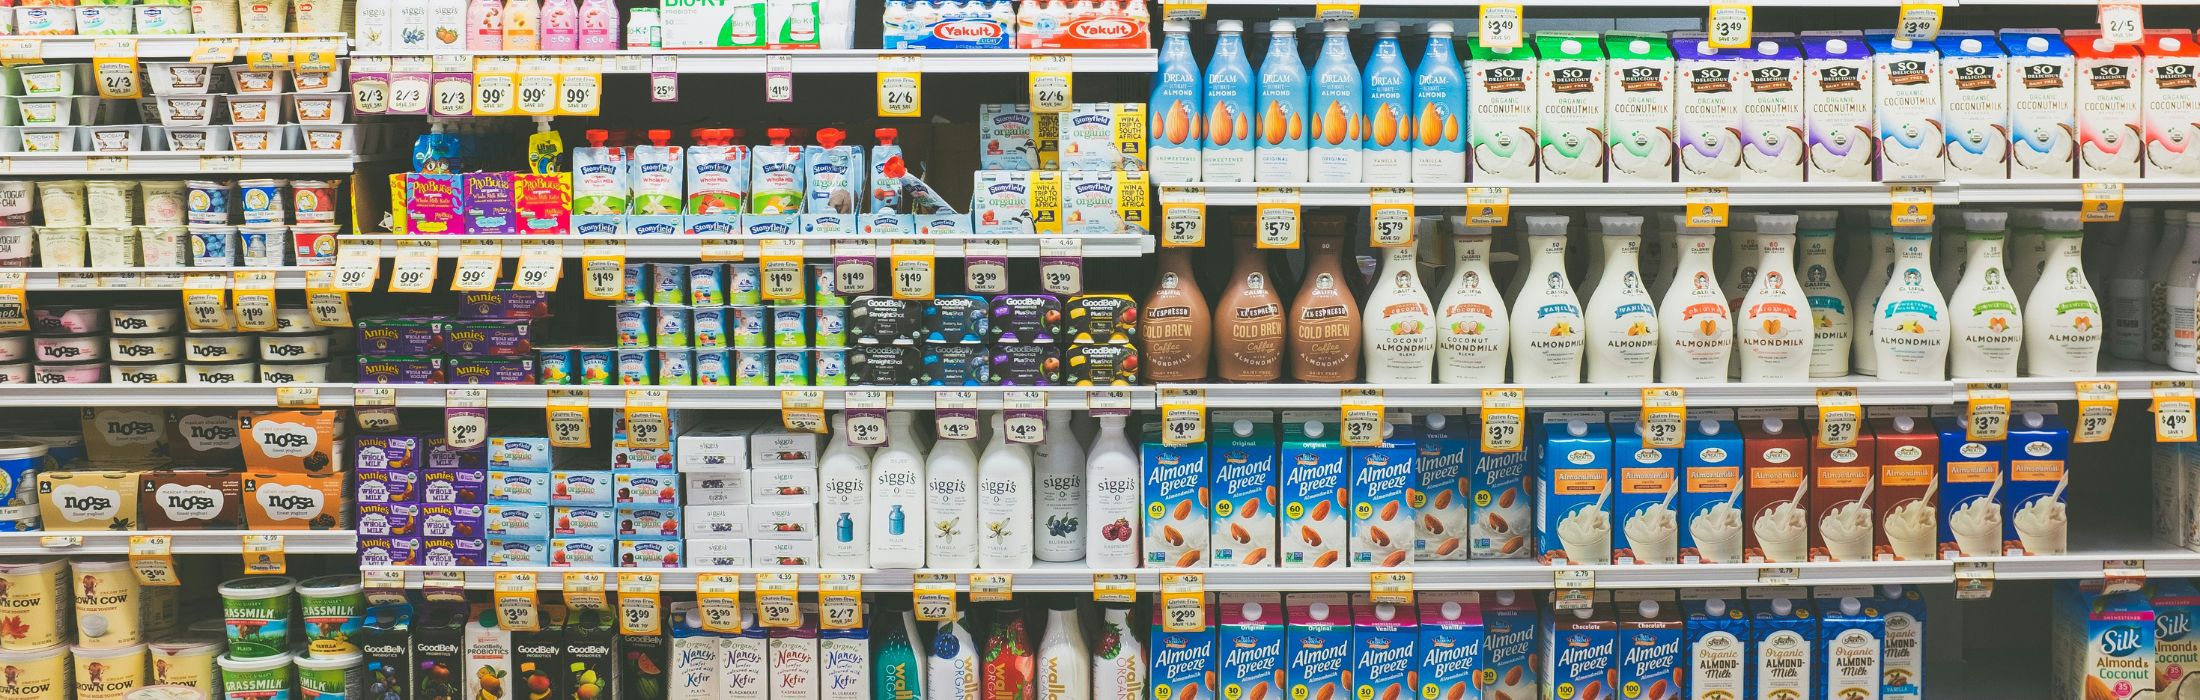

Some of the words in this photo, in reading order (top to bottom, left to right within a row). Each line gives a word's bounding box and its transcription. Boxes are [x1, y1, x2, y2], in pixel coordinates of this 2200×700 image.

[944, 25, 992, 38] Yakult
[1080, 25, 1127, 36] Yakult
[1494, 67, 1513, 77] SO
[1965, 66, 1986, 76] SO
[990, 183, 1026, 195] Stonyfield
[579, 223, 618, 235] Stonyfield
[750, 223, 788, 236] Stonyfield
[867, 300, 906, 310] GoodBelly
[934, 299, 973, 308] GoodBelly
[1299, 326, 1321, 338] COLD
[1323, 326, 1350, 338] BREW
[44, 346, 80, 358] noosa
[265, 433, 309, 447] noosa
[1148, 457, 1204, 486] Almond
[1216, 458, 1271, 485] Almond
[1287, 459, 1343, 487] Almond
[1356, 459, 1412, 486] Almond
[1160, 473, 1198, 496] Breeze
[1228, 474, 1266, 495] Breeze
[1299, 475, 1337, 497] Breeze
[1368, 475, 1406, 497] Breeze
[65, 496, 112, 511] noosa
[169, 497, 214, 511] noosa
[269, 496, 315, 510] noosa
[1152, 505, 1162, 513] 60
[1290, 505, 1300, 513] 60
[100, 595, 127, 605] COW
[417, 643, 458, 654] GoodBelly
[2101, 630, 2142, 655] Silk
[364, 645, 406, 655] GoodBelly
[518, 645, 559, 656] GoodBelly
[1155, 642, 1211, 669] Almond
[1224, 642, 1281, 669] Almond
[1292, 642, 1348, 669] Almond
[1423, 640, 1478, 668] Almond
[1558, 639, 1614, 667] Almond
[1700, 649, 1738, 660] Organic
[681, 649, 716, 669] Nancy's
[725, 649, 761, 669] Nancy's
[2097, 657, 2143, 669] Almond
[1167, 658, 1205, 681] Breeze
[1236, 658, 1275, 679] Breeze
[1305, 658, 1342, 680] Breeze
[1435, 657, 1473, 679] Breeze
[1570, 656, 1608, 678] Breeze
[1706, 668, 1731, 679] Milk
[1841, 667, 1868, 678] Milk
[2099, 669, 2149, 680] Coconut
[686, 673, 710, 691] Kefir
[729, 674, 755, 690] Kefir
[1158, 687, 1169, 696] 30
[1295, 688, 1305, 696] 30
[1426, 686, 1436, 694] 30
[1560, 686, 1572, 694] 100
